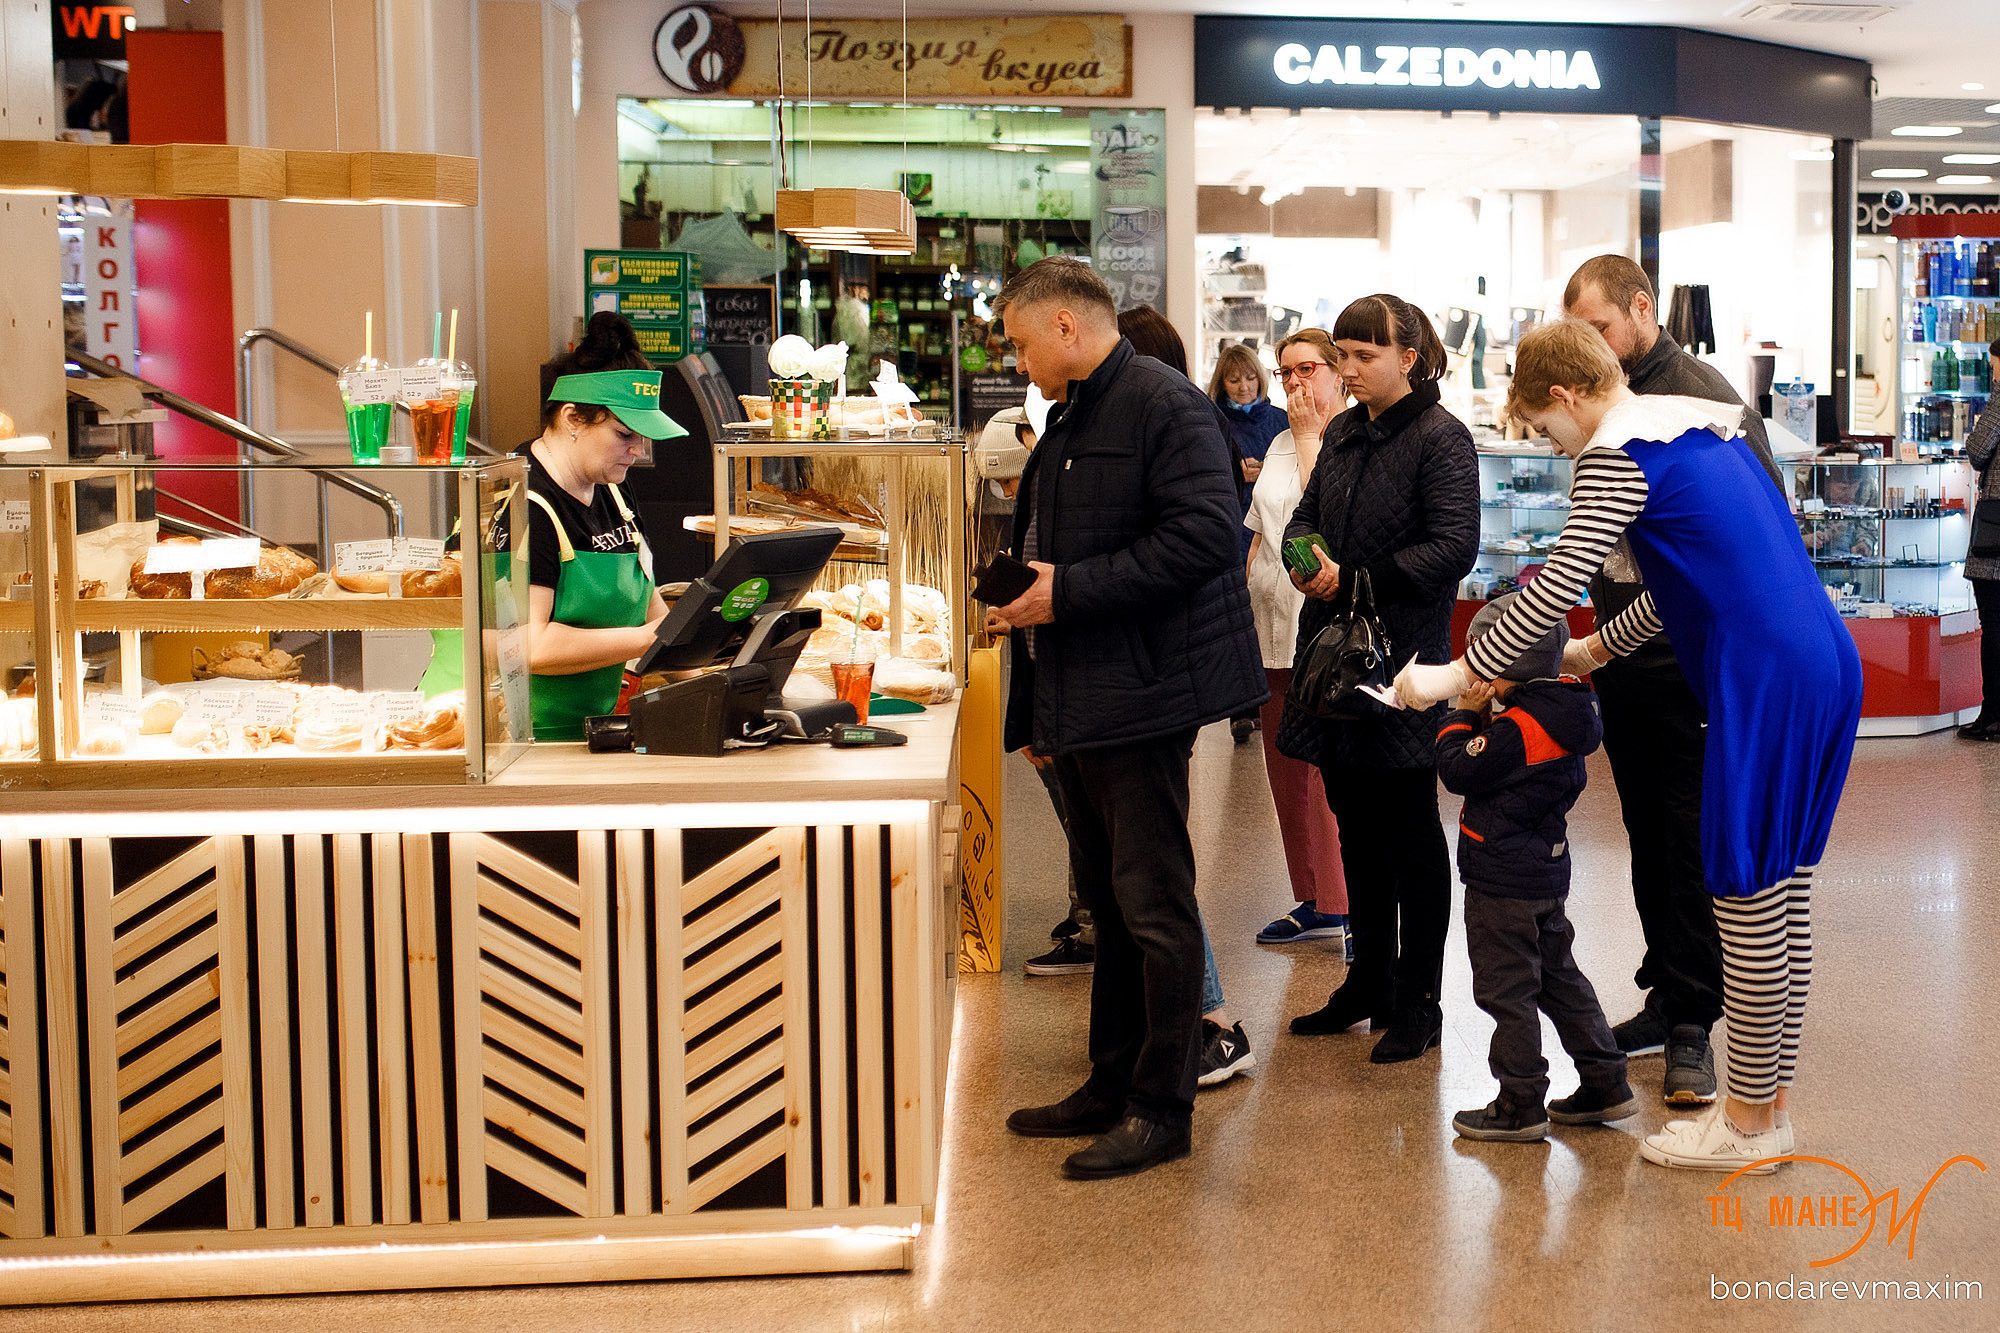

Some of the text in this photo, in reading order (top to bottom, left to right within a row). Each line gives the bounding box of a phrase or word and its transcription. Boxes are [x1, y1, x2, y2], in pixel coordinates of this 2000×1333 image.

[804, 29, 978, 72] Поэзия
[980, 48, 1103, 92] вкуса
[1273, 42, 1602, 90] CALZEDONIA
[1091, 127, 1143, 149] ЧАЙ
[1098, 246, 1155, 262] КОФЕ
[620, 260, 679, 269] ОБСЛУЖИВАНИЕ
[622, 268, 678, 276] ПЛАСТИКОВЫХ
[628, 294, 652, 302] ОПЛАТА
[632, 382, 660, 396] ТЕС
